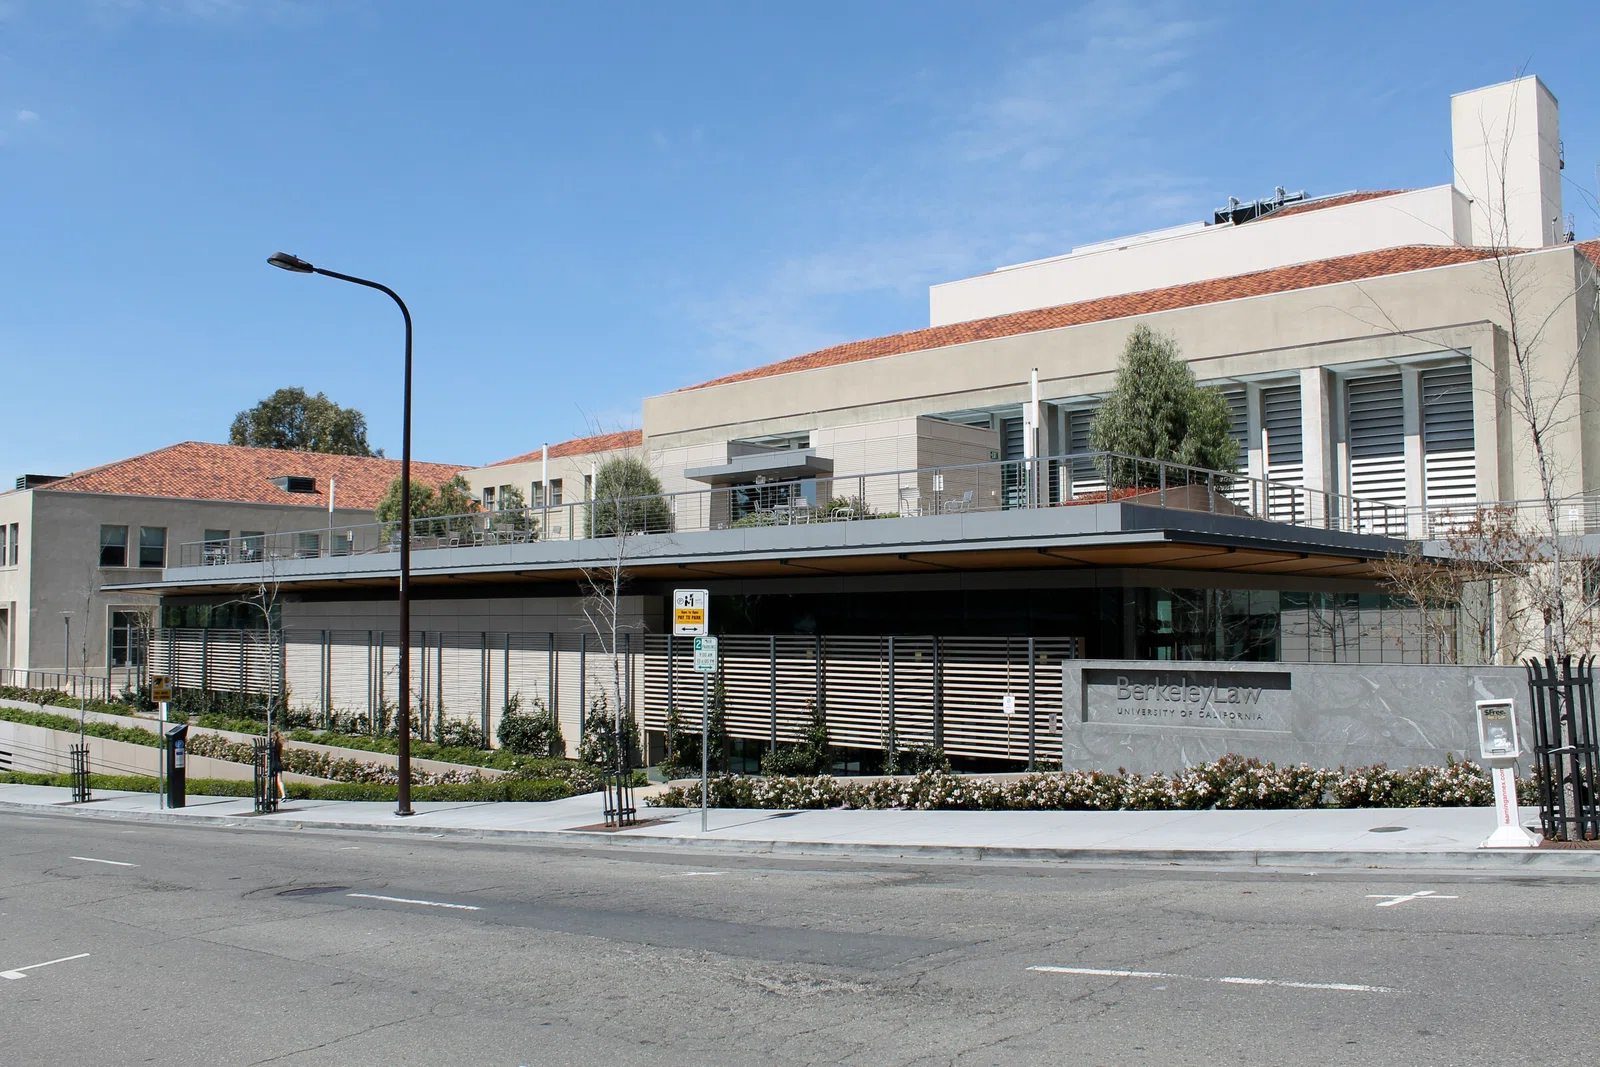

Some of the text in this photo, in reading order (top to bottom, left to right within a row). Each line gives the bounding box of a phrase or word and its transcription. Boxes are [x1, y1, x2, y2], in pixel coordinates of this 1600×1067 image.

[696, 640, 701, 648] 2
[1117, 707, 1264, 721] UNIVERSITY OF CALIFORNIA
[1500, 768, 1510, 824] learningannex.com
